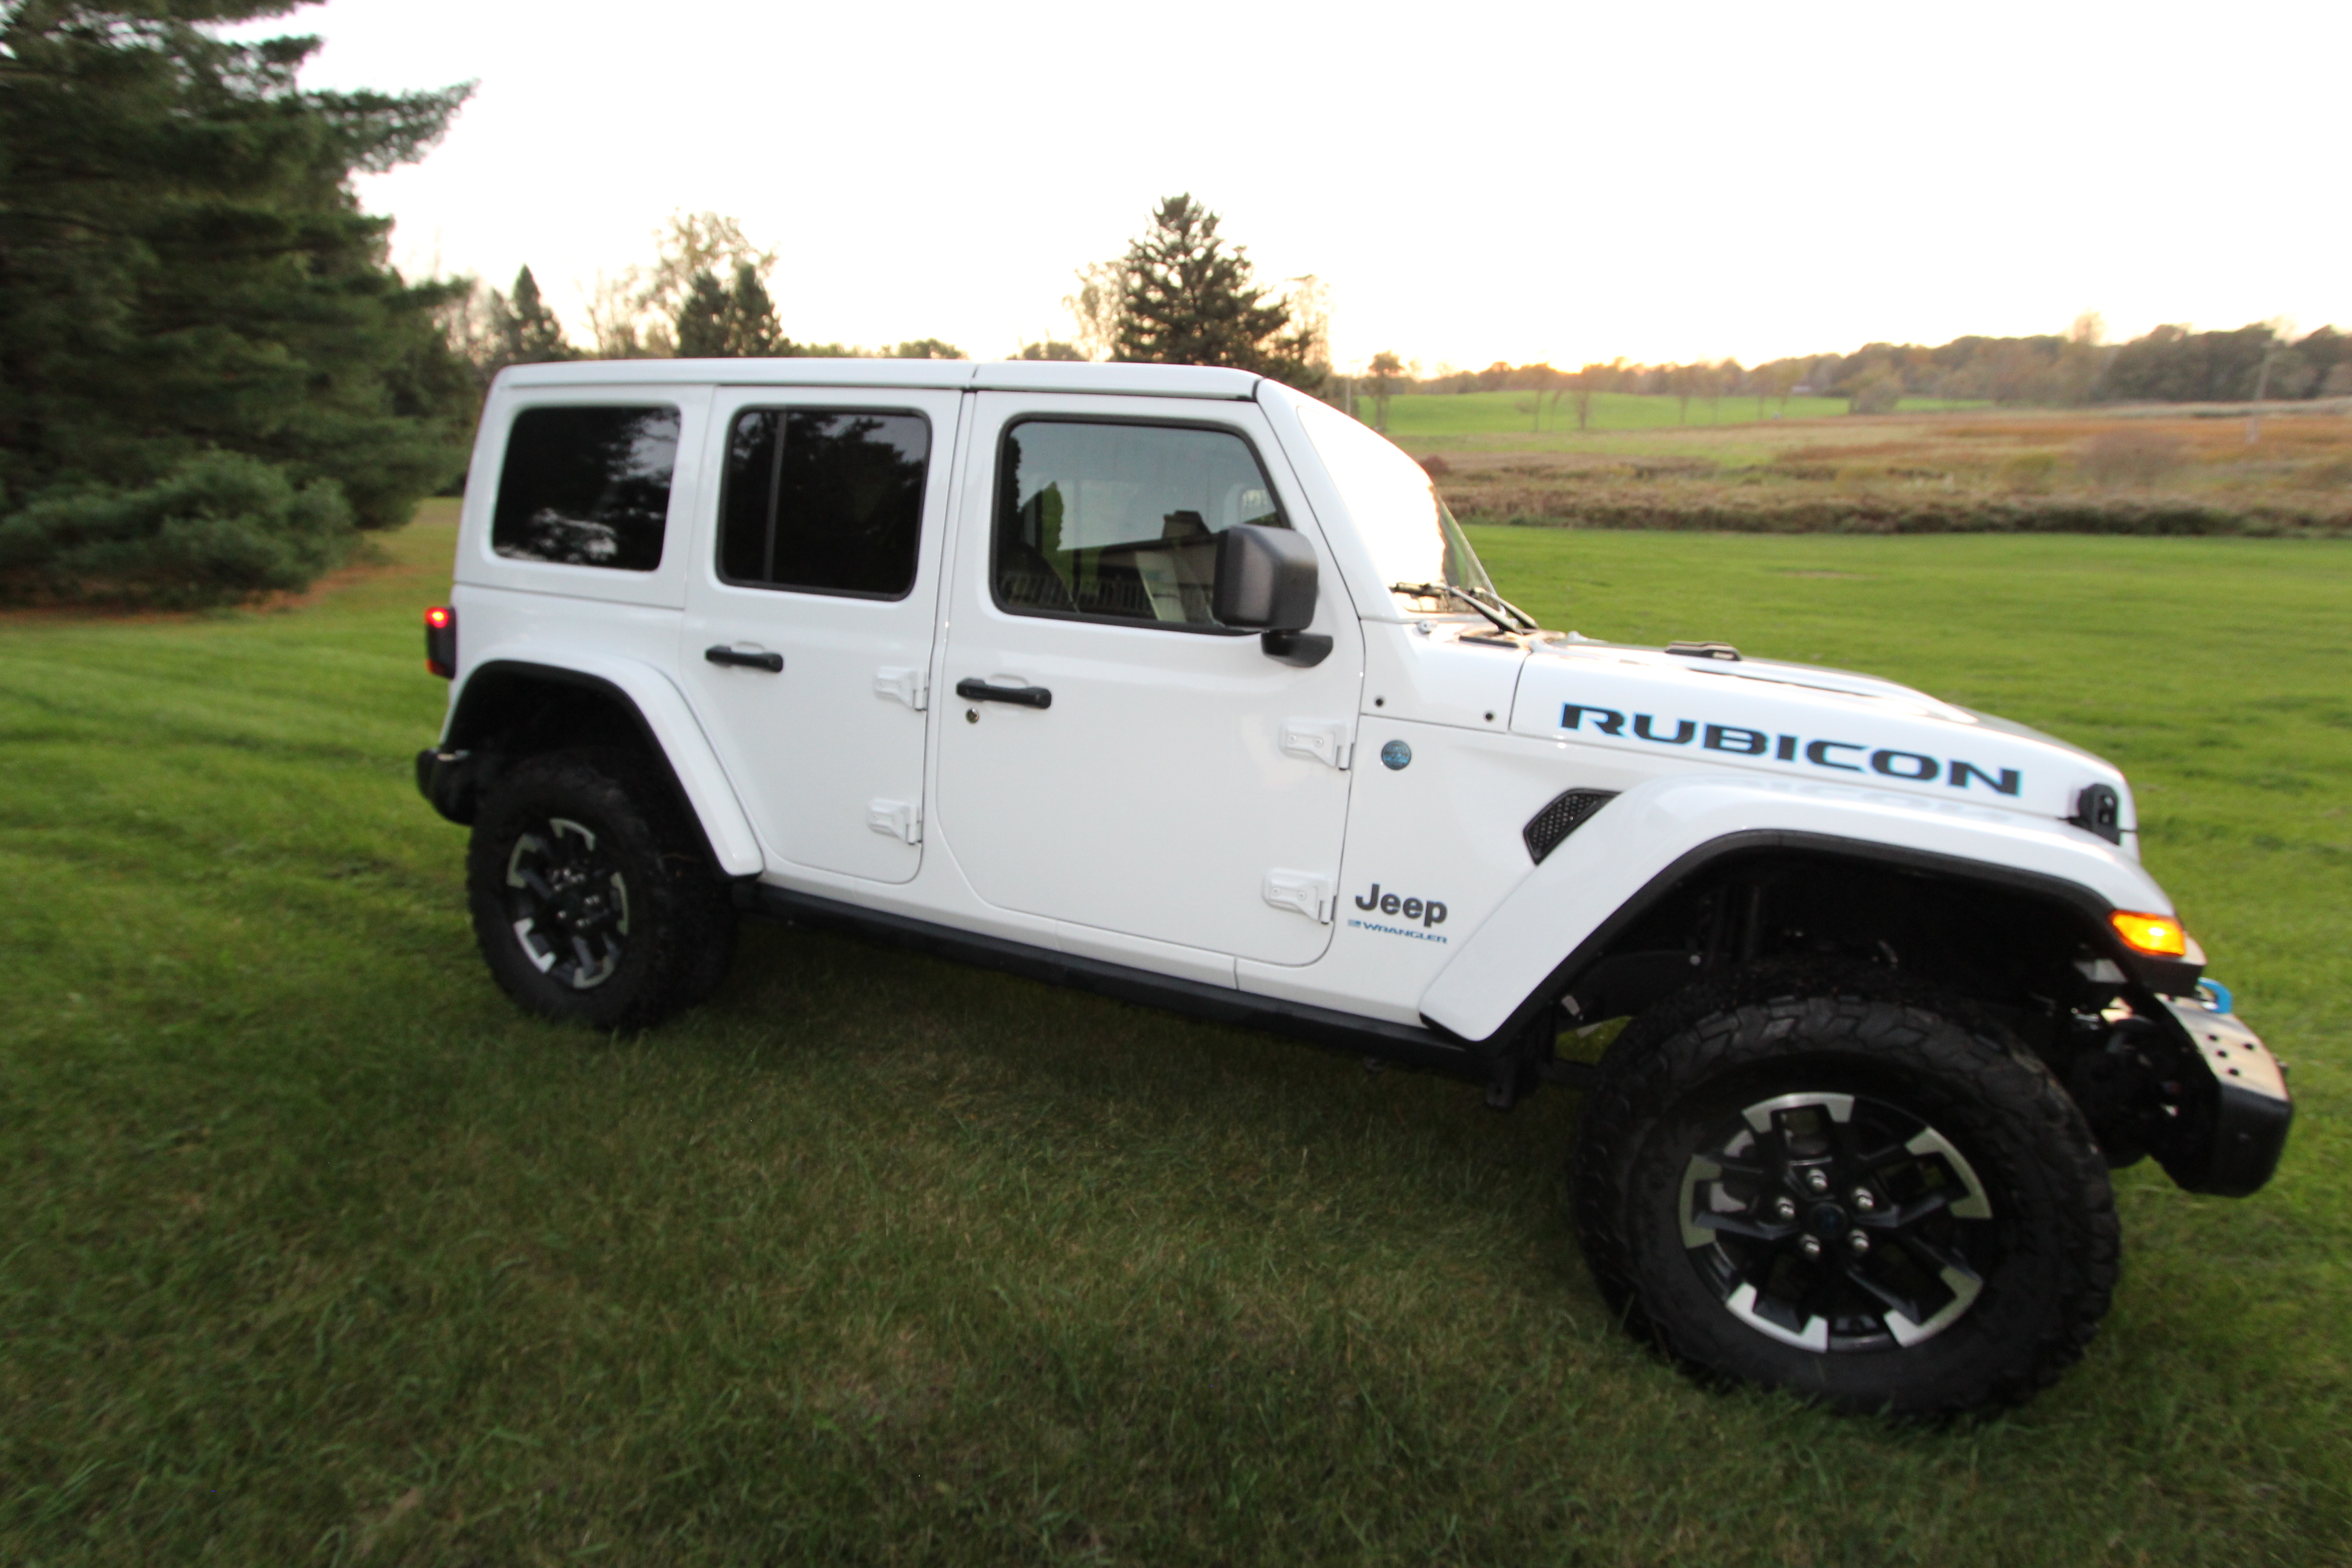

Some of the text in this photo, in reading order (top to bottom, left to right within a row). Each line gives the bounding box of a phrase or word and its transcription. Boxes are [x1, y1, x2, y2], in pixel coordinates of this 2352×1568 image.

[1560, 703, 2021, 796] RUBICON
[1355, 883, 1448, 928] Jeep
[1362, 921, 1448, 943] WRANGLER
